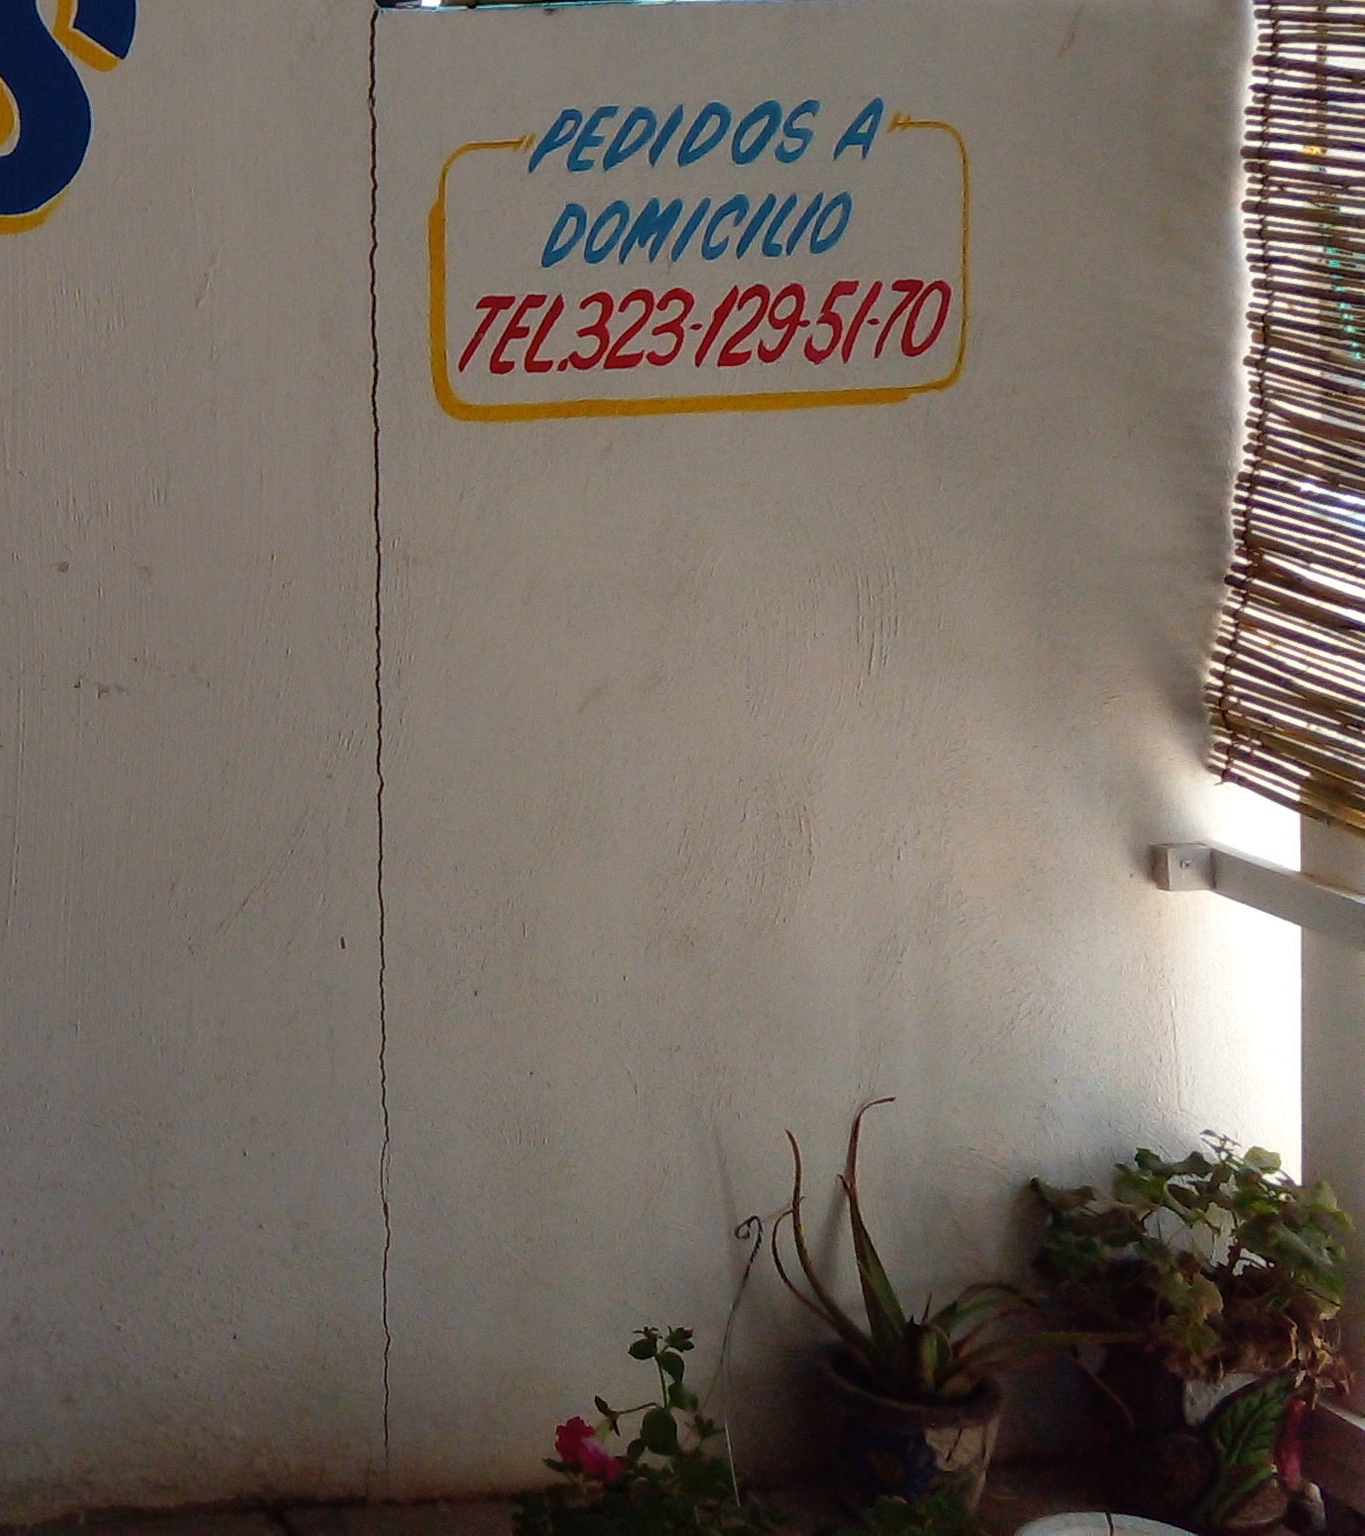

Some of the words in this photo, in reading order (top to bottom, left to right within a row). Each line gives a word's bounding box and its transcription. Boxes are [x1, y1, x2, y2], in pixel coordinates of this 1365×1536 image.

[527, 98, 821, 174] PEDIDOS
[833, 96, 886, 161] A
[541, 190, 853, 268] DOMICILIO
